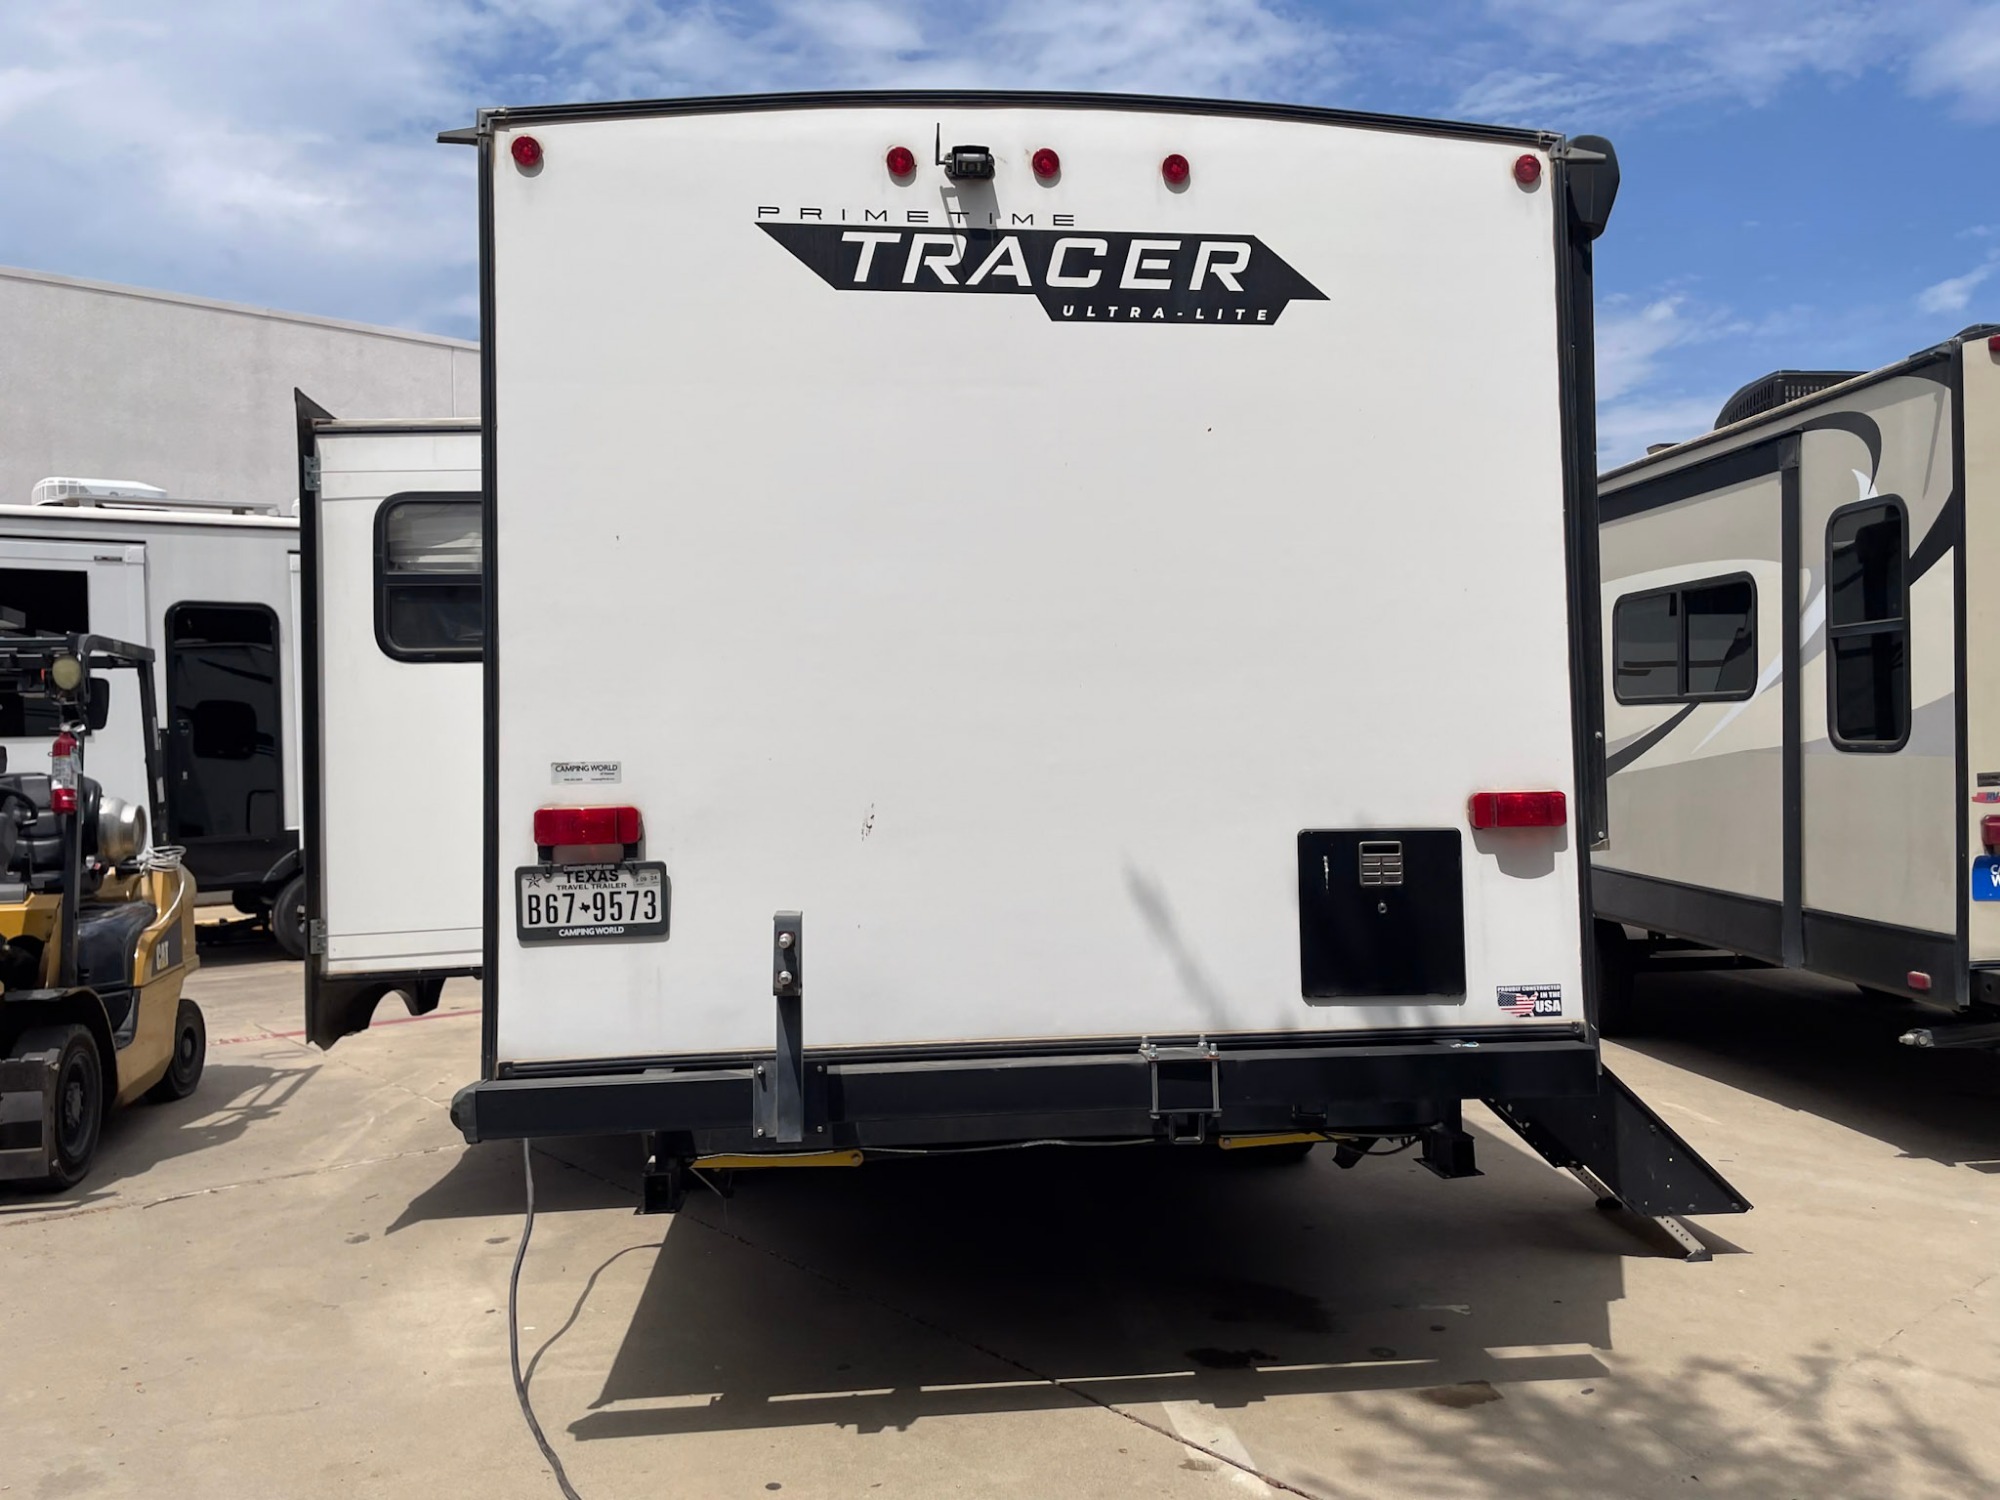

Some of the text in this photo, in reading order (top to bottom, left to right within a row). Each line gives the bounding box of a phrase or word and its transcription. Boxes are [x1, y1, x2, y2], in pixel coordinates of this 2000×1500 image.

[840, 231, 1252, 292] TRACER
[1062, 304, 1269, 321] ULTRA-LITE
[555, 764, 618, 773] CAMPING WORLD
[564, 870, 619, 884] TEXAS
[591, 882, 628, 890] TRAILER
[528, 890, 657, 925] B67 9573
[559, 926, 625, 937] CAMPING WORLD
[156, 941, 169, 970] CAT
[1535, 1000, 1560, 1012] USA
